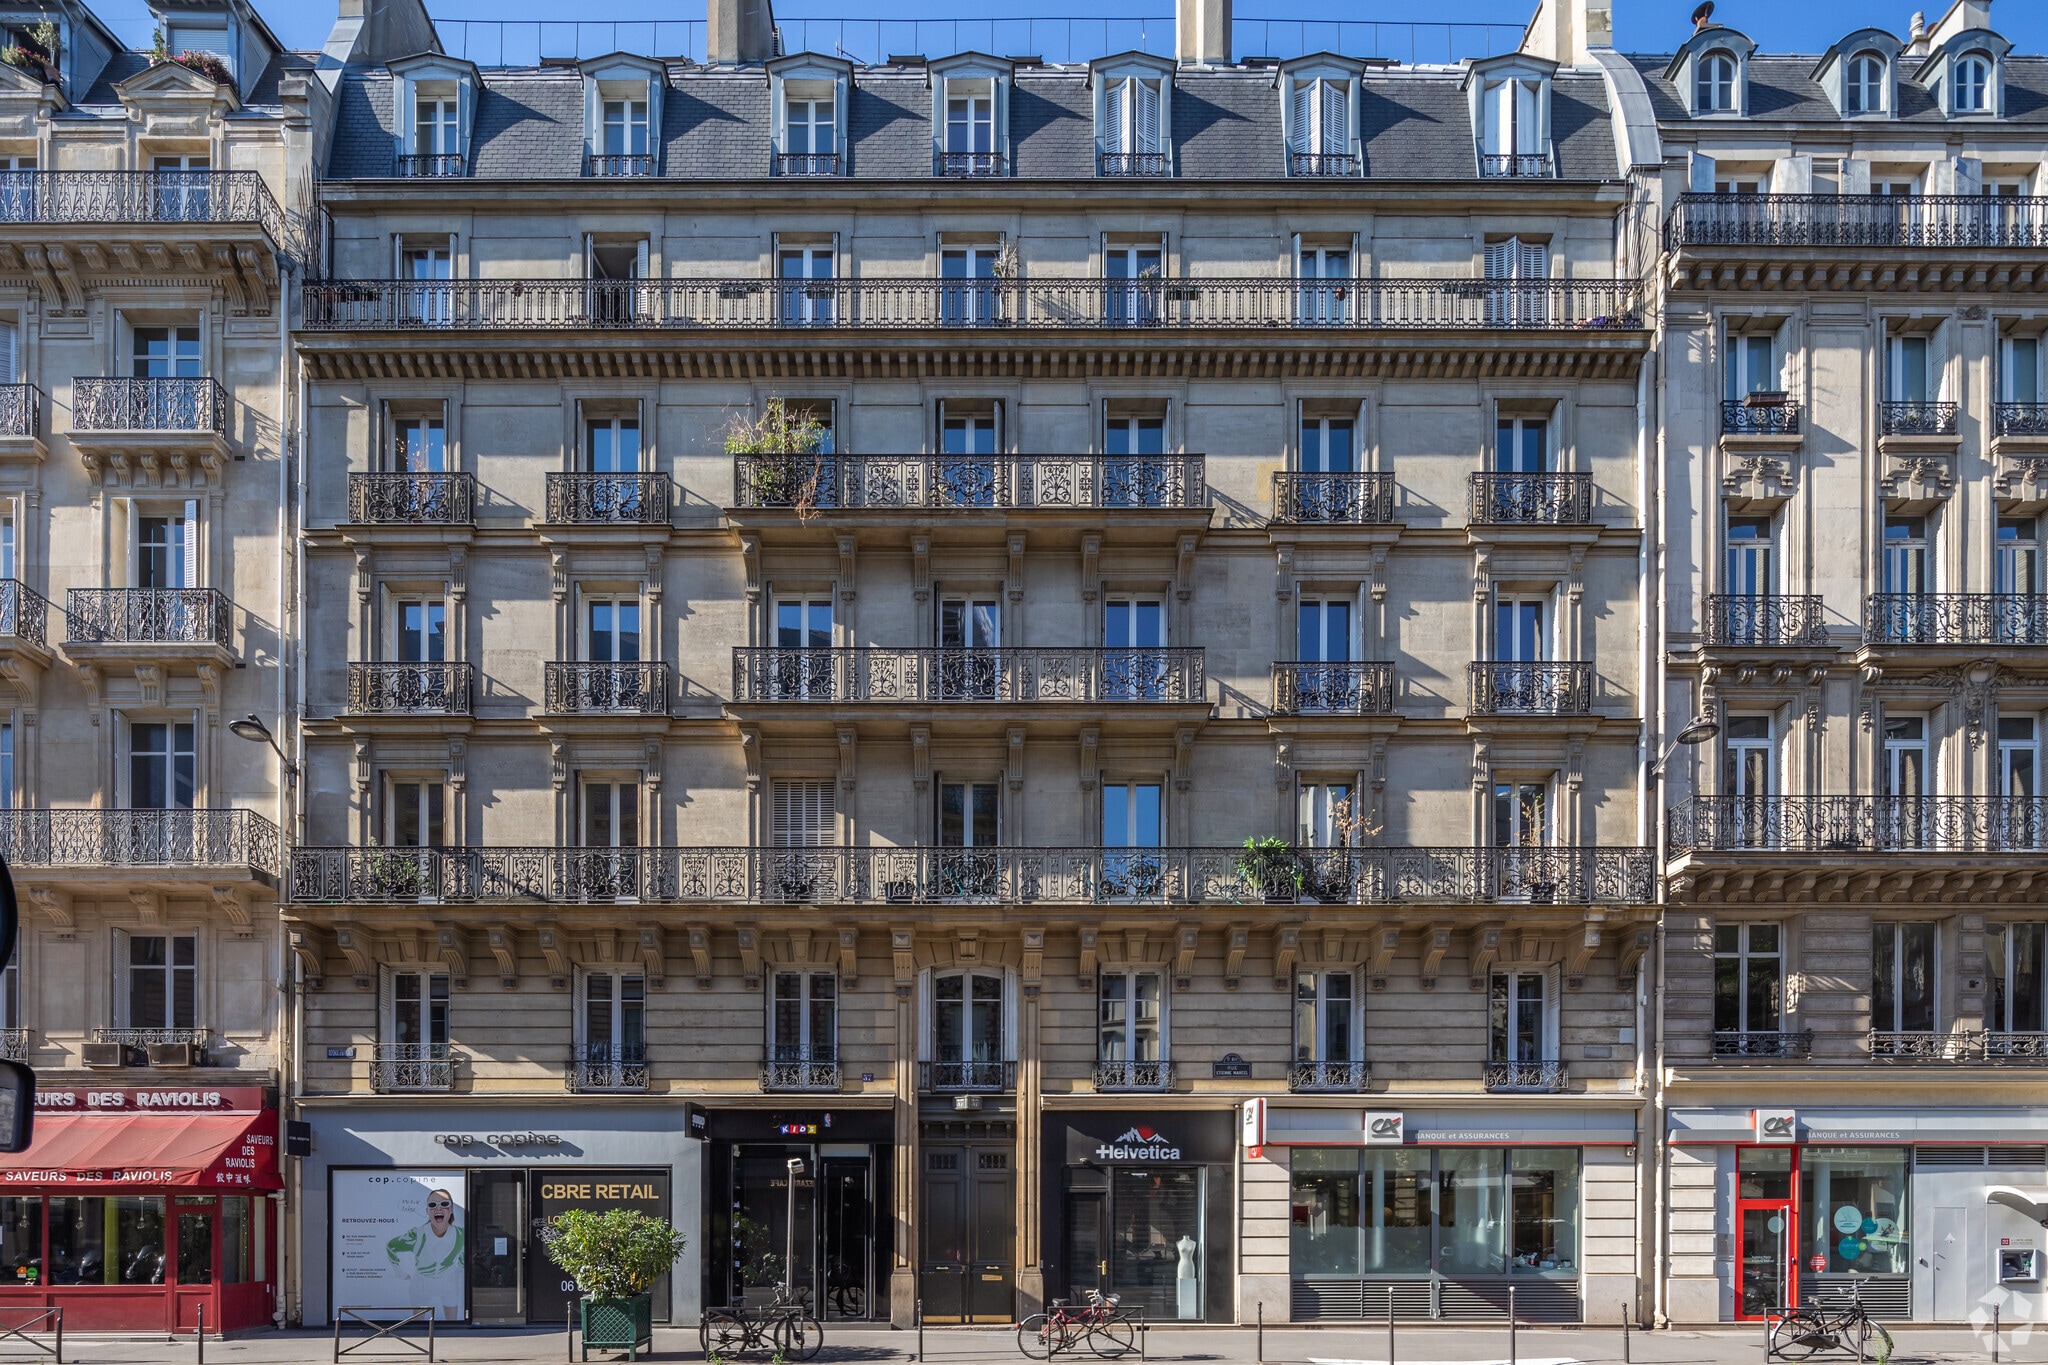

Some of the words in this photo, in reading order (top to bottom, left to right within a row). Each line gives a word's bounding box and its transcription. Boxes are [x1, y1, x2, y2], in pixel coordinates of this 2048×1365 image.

[87, 1092, 125, 1106] DES
[136, 1092, 221, 1107] RAVIOLIS
[781, 1125, 815, 1134] KIDS
[246, 1134, 274, 1145] SAVEURS
[1415, 1132, 1446, 1140] BANQUE
[242, 1146, 255, 1155] DES
[1096, 1144, 1180, 1160] Helvetica
[225, 1158, 255, 1168] RAVIOLIS
[5, 1171, 67, 1182] SAVEURS
[76, 1172, 103, 1182] DES
[112, 1171, 173, 1181] RAVIOLIS
[368, 1176, 436, 1184] cop.copine
[541, 1184, 591, 1199] CBRE
[595, 1184, 660, 1199] RETAIL
[561, 1281, 574, 1291] 06
